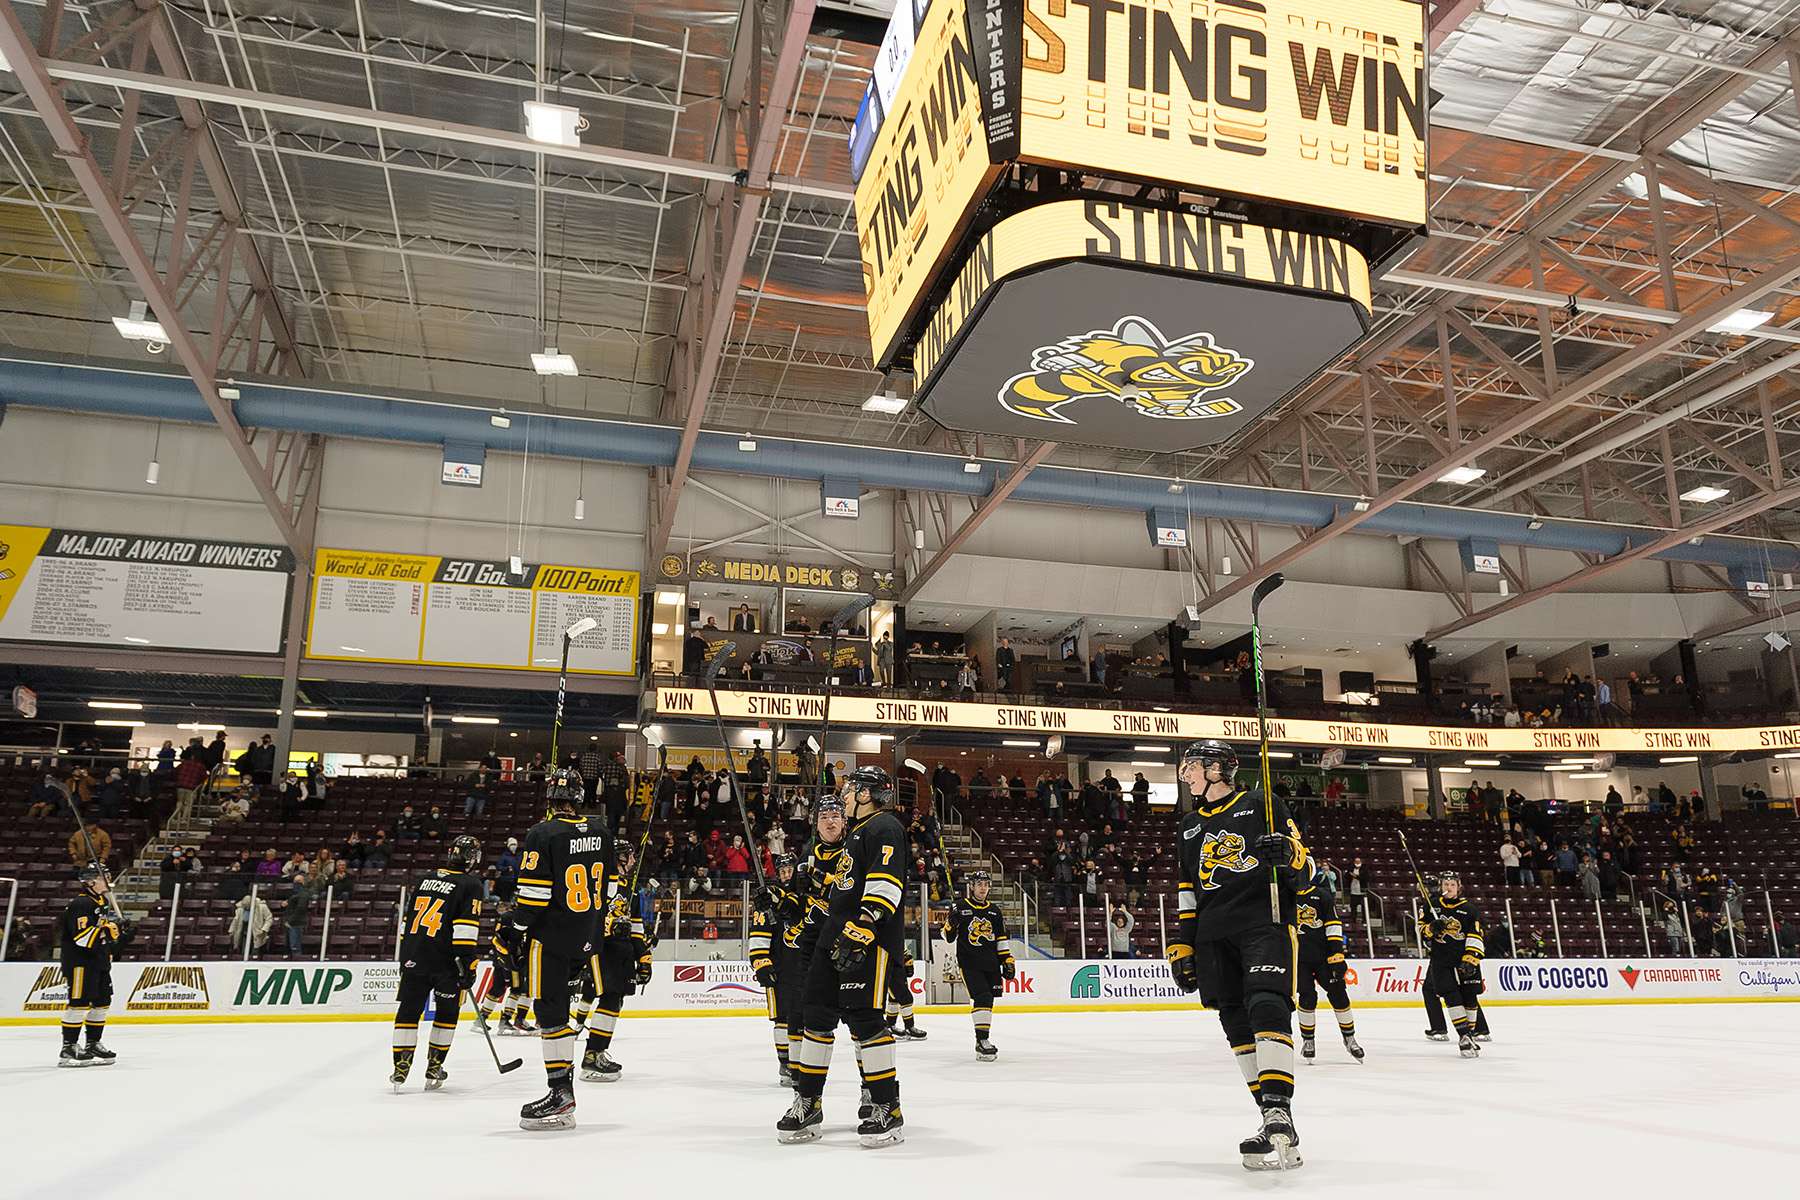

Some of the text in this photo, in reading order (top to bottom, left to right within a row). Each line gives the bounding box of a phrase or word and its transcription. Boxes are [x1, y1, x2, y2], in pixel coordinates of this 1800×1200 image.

[921, 12, 977, 167] WIN
[1288, 41, 1424, 136] WIN
[1190, 204, 1209, 214] OES
[1085, 200, 1350, 295] STING WIN
[958, 228, 994, 324] WIN
[56, 534, 281, 568] MAJOR AWARD WINNERS
[325, 559, 422, 581] World JR Gold
[442, 561, 475, 583] 50
[475, 563, 510, 586] Go
[724, 561, 833, 587] MEDIA DECK
[539, 568, 576, 589] 100
[574, 571, 624, 594] Point
[664, 692, 694, 711] WIN
[748, 696, 825, 718] STING WIN
[876, 702, 948, 723] STING WIN
[998, 708, 1067, 729] STING WIN
[1113, 714, 1179, 734] STING WIN
[1223, 720, 1287, 739] STING WIN
[1328, 725, 1388, 744] STING WIN
[1429, 730, 1489, 748] STING WIN
[1533, 732, 1600, 748] STING WIN
[1645, 732, 1711, 748] STING WIN
[1760, 729, 1800, 746] STING
[1233, 809, 1254, 818] CCM
[569, 837, 602, 855] ROMEO
[881, 845, 894, 866] 7
[565, 862, 604, 913] 83
[409, 896, 446, 938] 74
[1104, 965, 1170, 979] Monteith
[1250, 965, 1286, 974] CCM
[1372, 966, 1409, 993] Tim
[1538, 967, 1609, 989] COGECO
[1644, 968, 1722, 983] CANADIAN TIRE
[131, 966, 208, 995] HOLLINWORTH
[233, 968, 353, 1005] MNP
[840, 982, 866, 990] CCM
[1739, 970, 1795, 992] Culligan
[40, 992, 68, 1001] Asphal
[143, 991, 196, 1001] Asphalt Repair
[362, 993, 377, 1001] TAX
